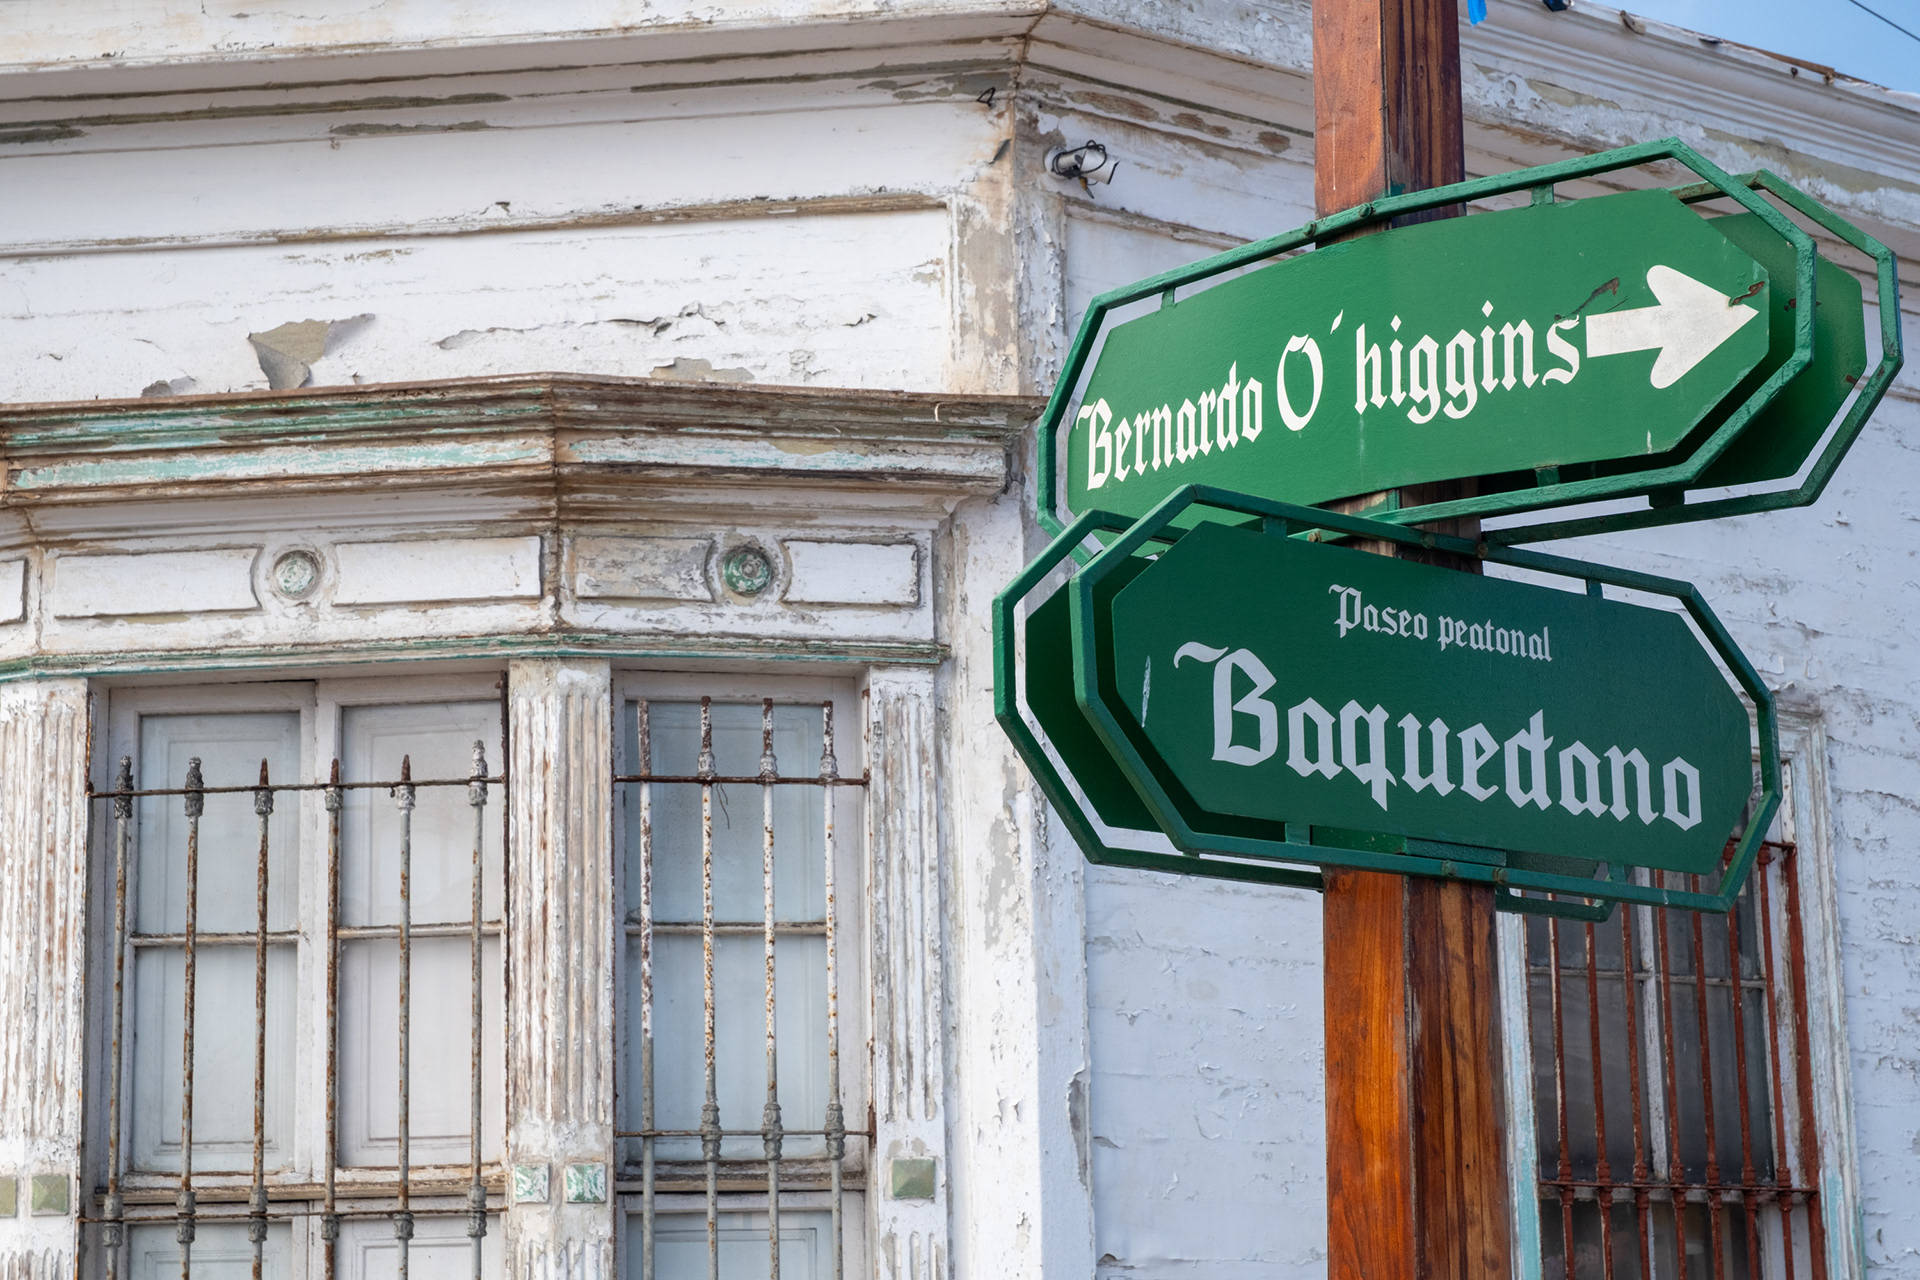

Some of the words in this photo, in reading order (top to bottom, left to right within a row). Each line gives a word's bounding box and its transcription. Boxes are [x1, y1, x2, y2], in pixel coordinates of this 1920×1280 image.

[1075, 359, 1263, 491] Bernardo
[1328, 584, 1428, 640] Paseo
[1438, 616, 1553, 663] peatonal
[1173, 641, 1703, 832] Baquedano
